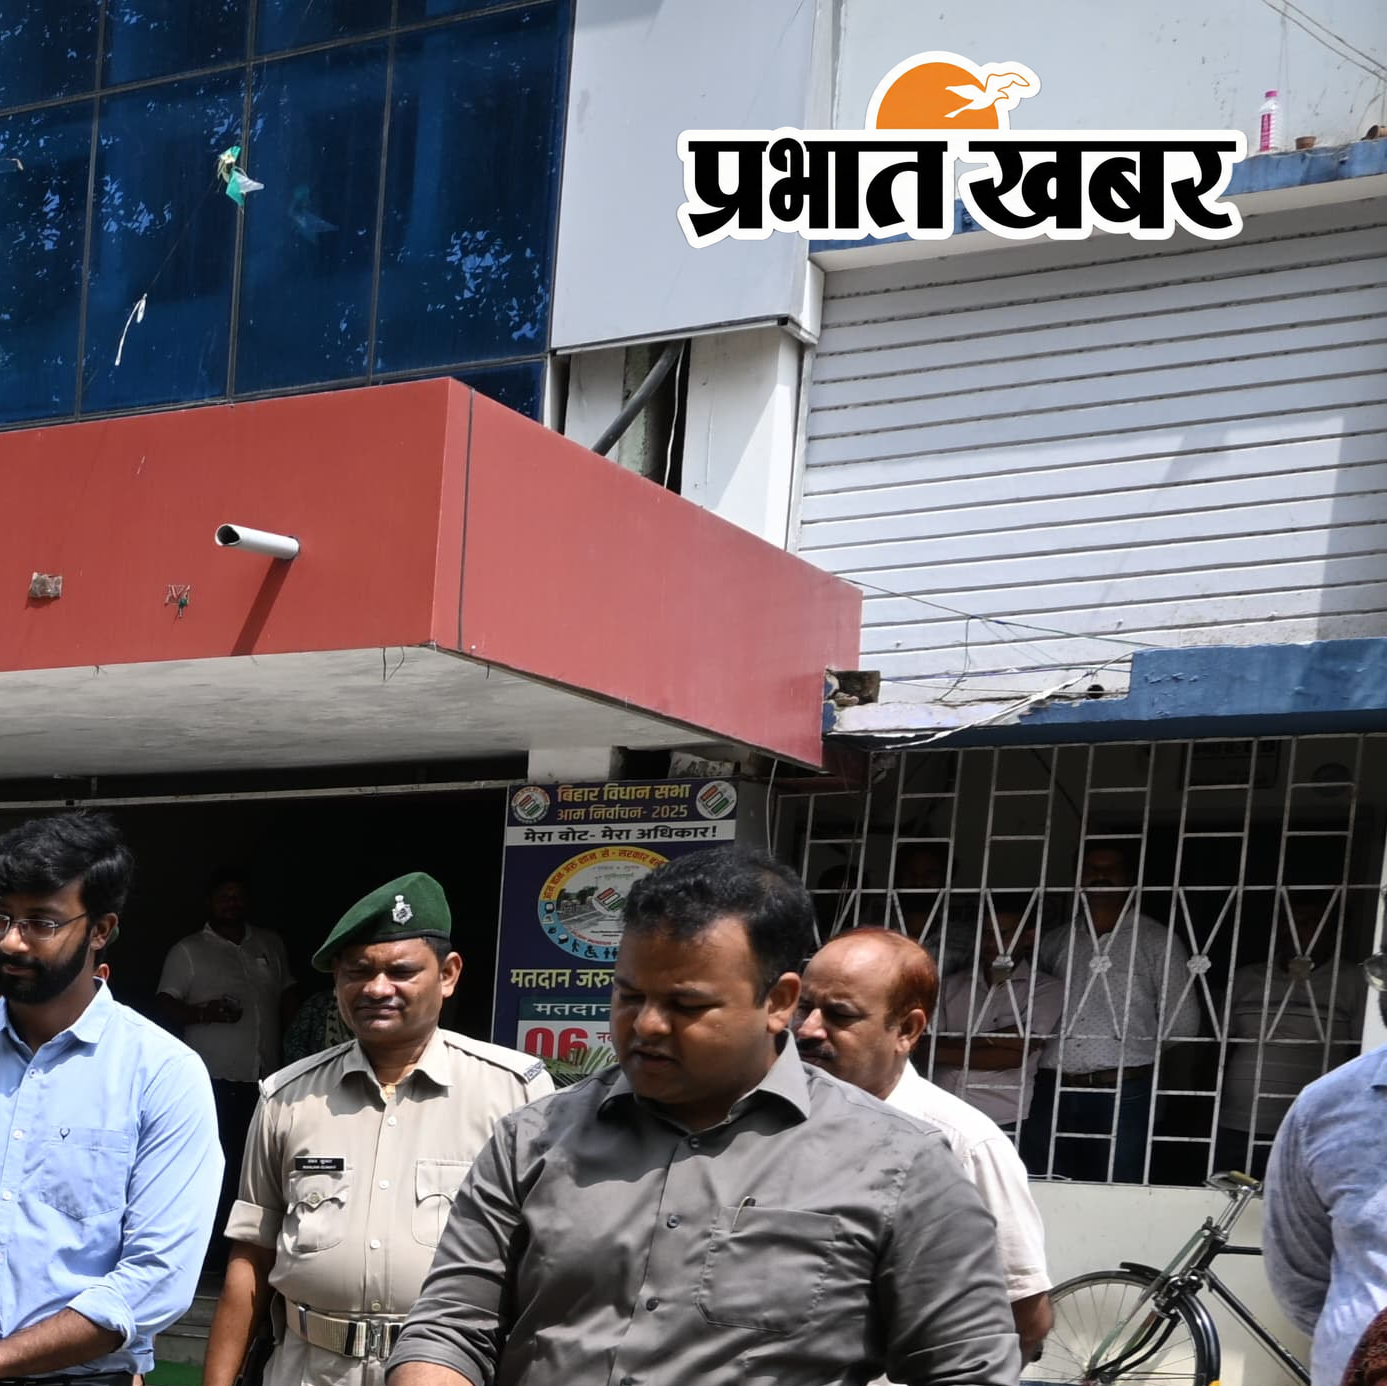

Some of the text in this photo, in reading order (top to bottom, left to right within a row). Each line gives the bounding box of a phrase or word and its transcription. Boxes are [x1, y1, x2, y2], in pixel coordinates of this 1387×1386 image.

[556, 782, 692, 803] बिहार विधान सभा
[556, 806, 584, 822] आम
[651, 804, 689, 819] 2025
[524, 826, 553, 843] मेरा
[601, 825, 629, 841] मेरा
[637, 824, 717, 840] अधिकार!
[510, 968, 615, 989] मतदान जरु
[524, 1027, 589, 1066] 06
